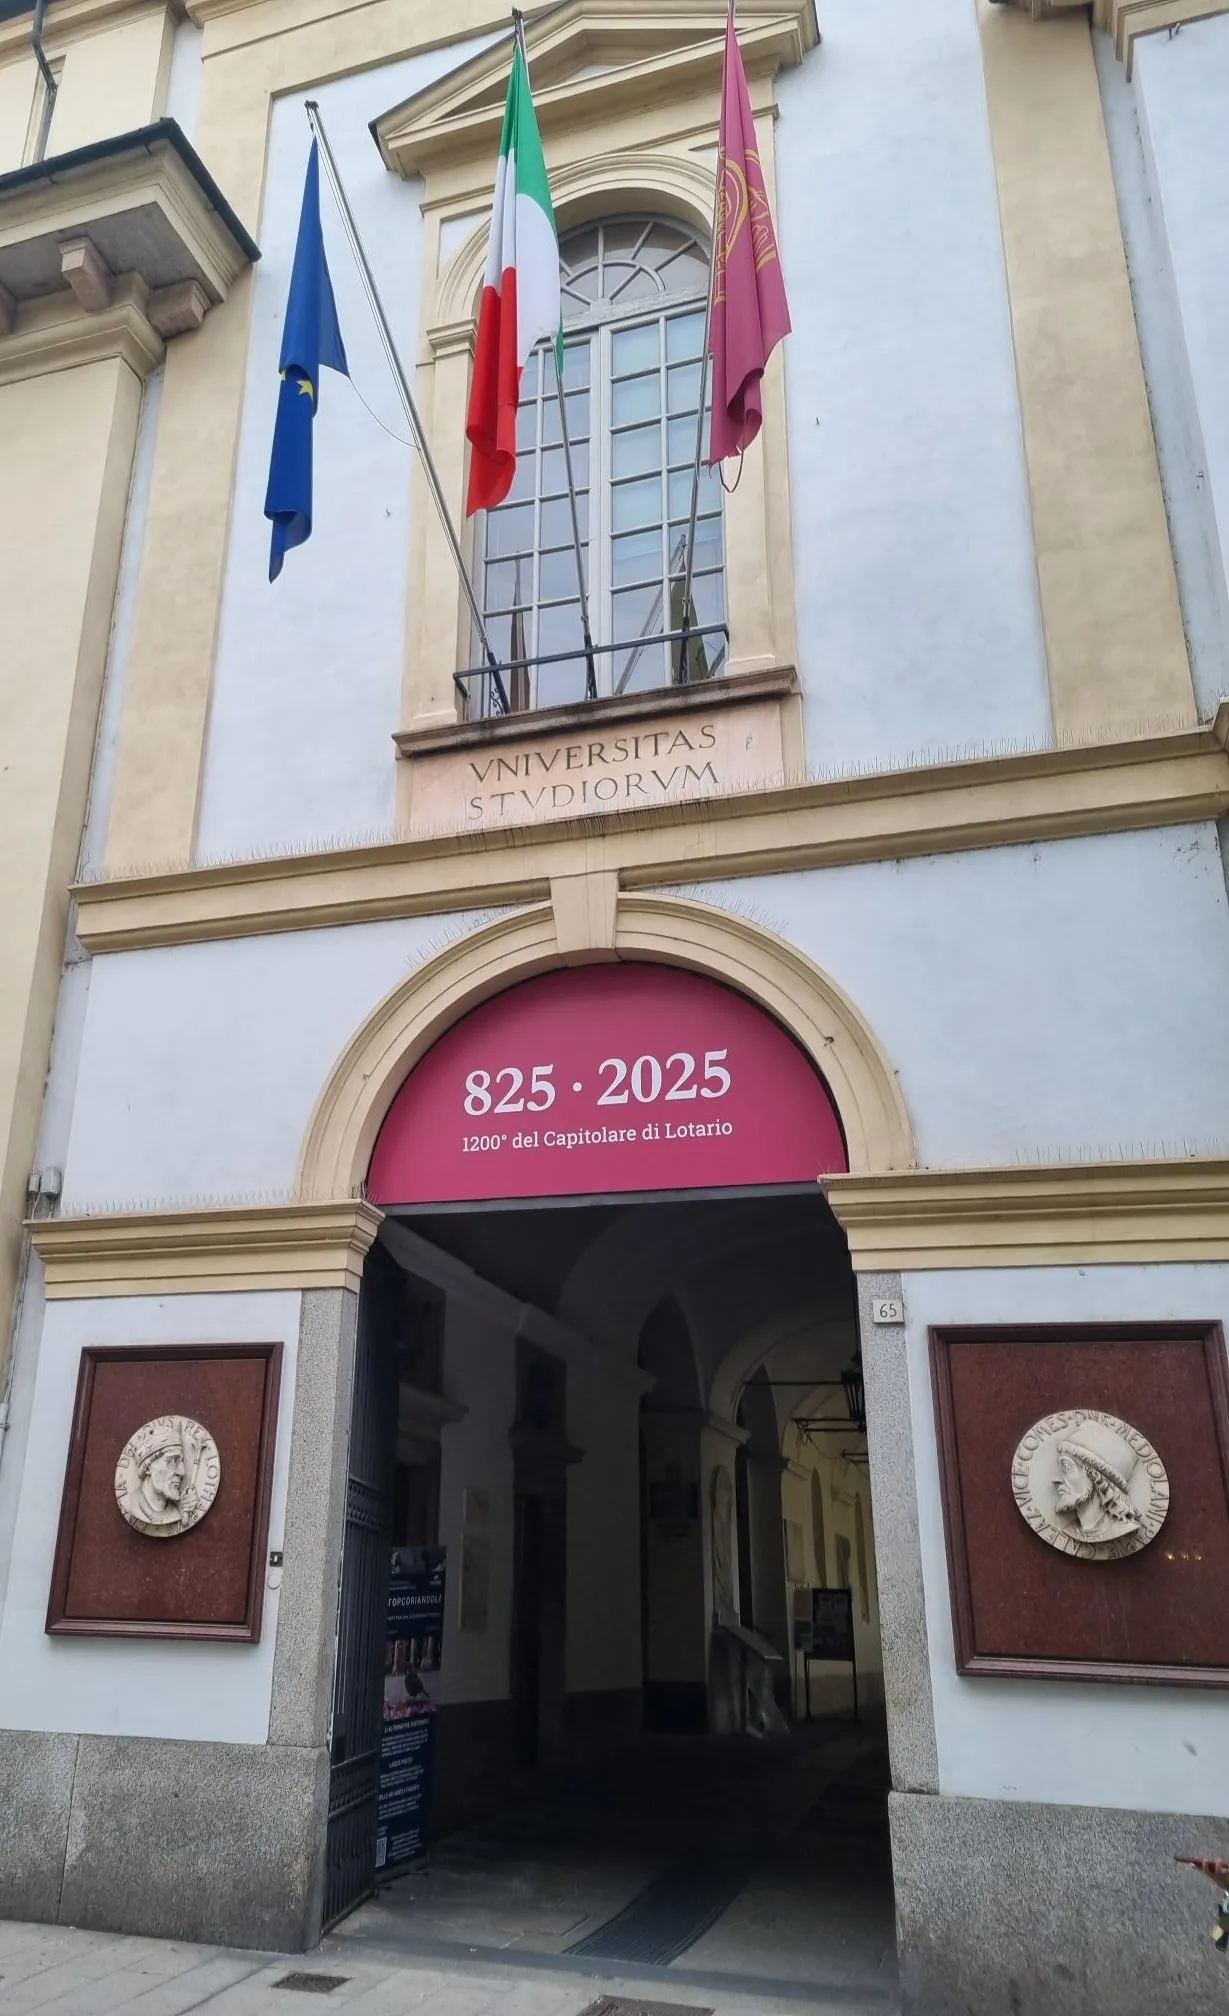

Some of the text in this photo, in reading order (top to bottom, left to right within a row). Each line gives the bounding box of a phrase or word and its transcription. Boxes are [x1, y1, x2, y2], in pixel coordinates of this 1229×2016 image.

[469, 724, 717, 783] VNIVERSITAS
[468, 761, 720, 820] STVDIORVM
[464, 1064, 556, 1116] 825
[597, 1049, 731, 1105] 2025
[512, 1132, 539, 1149] del
[543, 1126, 637, 1149] Capitolare
[642, 1123, 661, 1140] di
[665, 1119, 733, 1139] Lotario
[880, 1303, 897, 1318] 65
